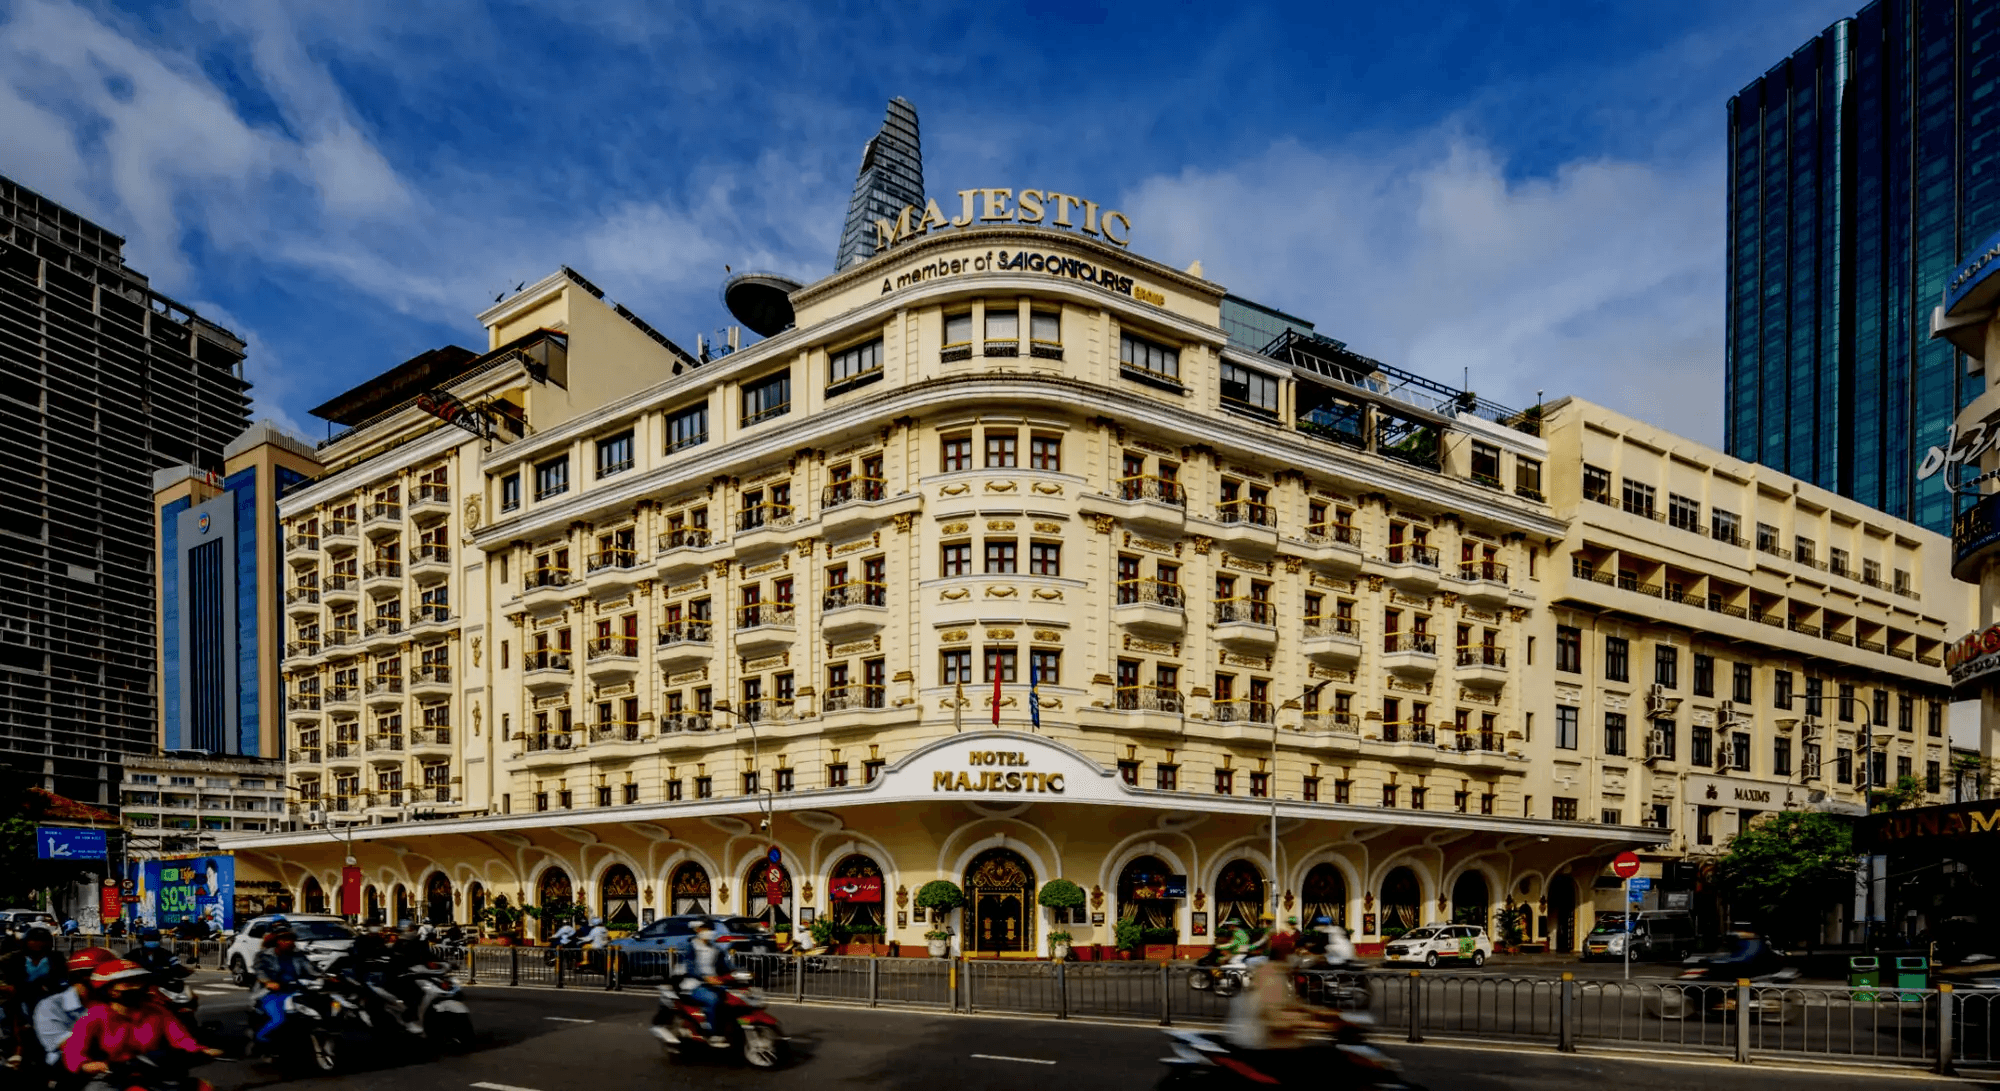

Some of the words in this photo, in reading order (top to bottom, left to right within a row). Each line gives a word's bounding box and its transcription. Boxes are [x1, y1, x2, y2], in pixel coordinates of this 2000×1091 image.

[874, 188, 1131, 252] MAJESTIC
[881, 278, 893, 295] A
[897, 257, 969, 288] member
[974, 251, 992, 271] of
[997, 250, 1134, 295] SAIGONTOURIST
[969, 751, 1029, 766] HOTEL
[933, 771, 1065, 792] MAJESTIC
